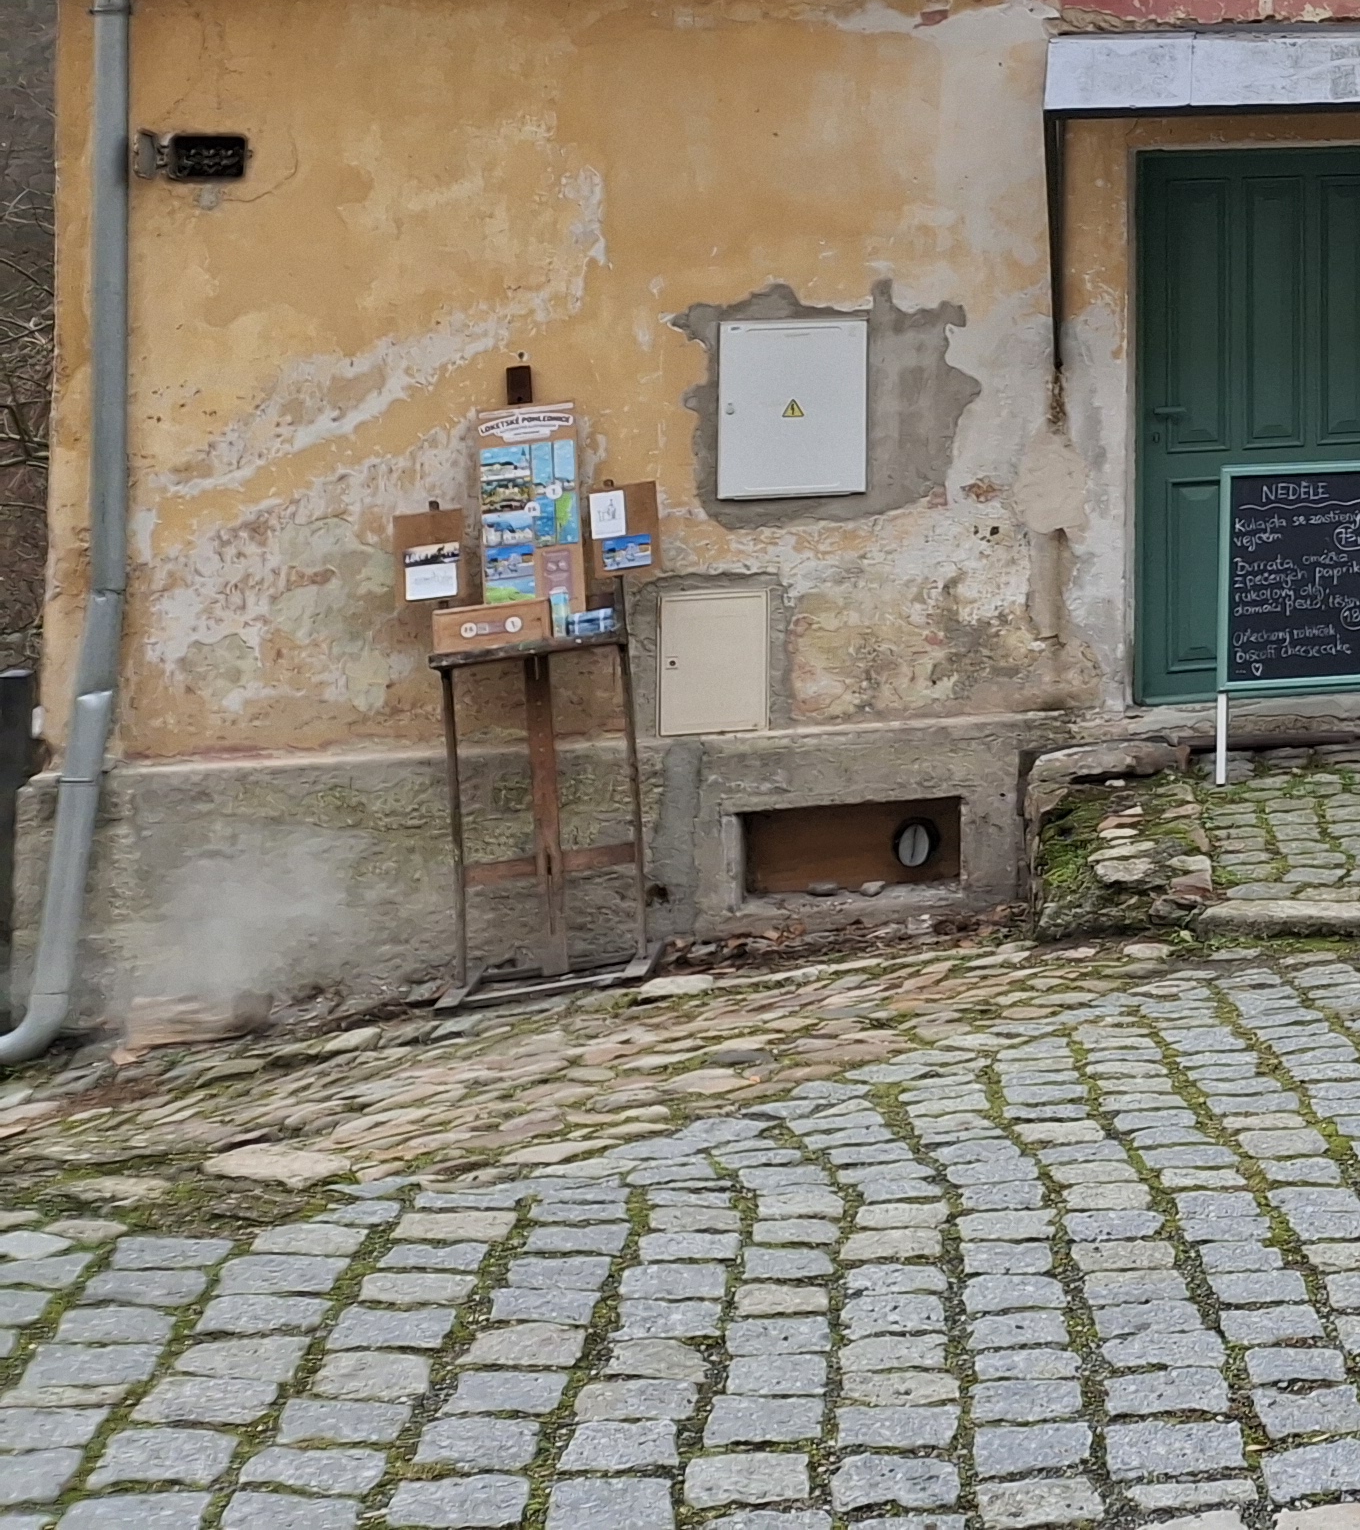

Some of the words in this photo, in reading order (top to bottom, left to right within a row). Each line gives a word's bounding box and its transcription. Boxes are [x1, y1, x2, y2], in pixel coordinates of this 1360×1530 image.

[1262, 481, 1330, 503] NEDĚLE
[1235, 513, 1287, 535] Kulajda
[1292, 516, 1306, 526] se
[1281, 633, 1352, 658] cheesecake
